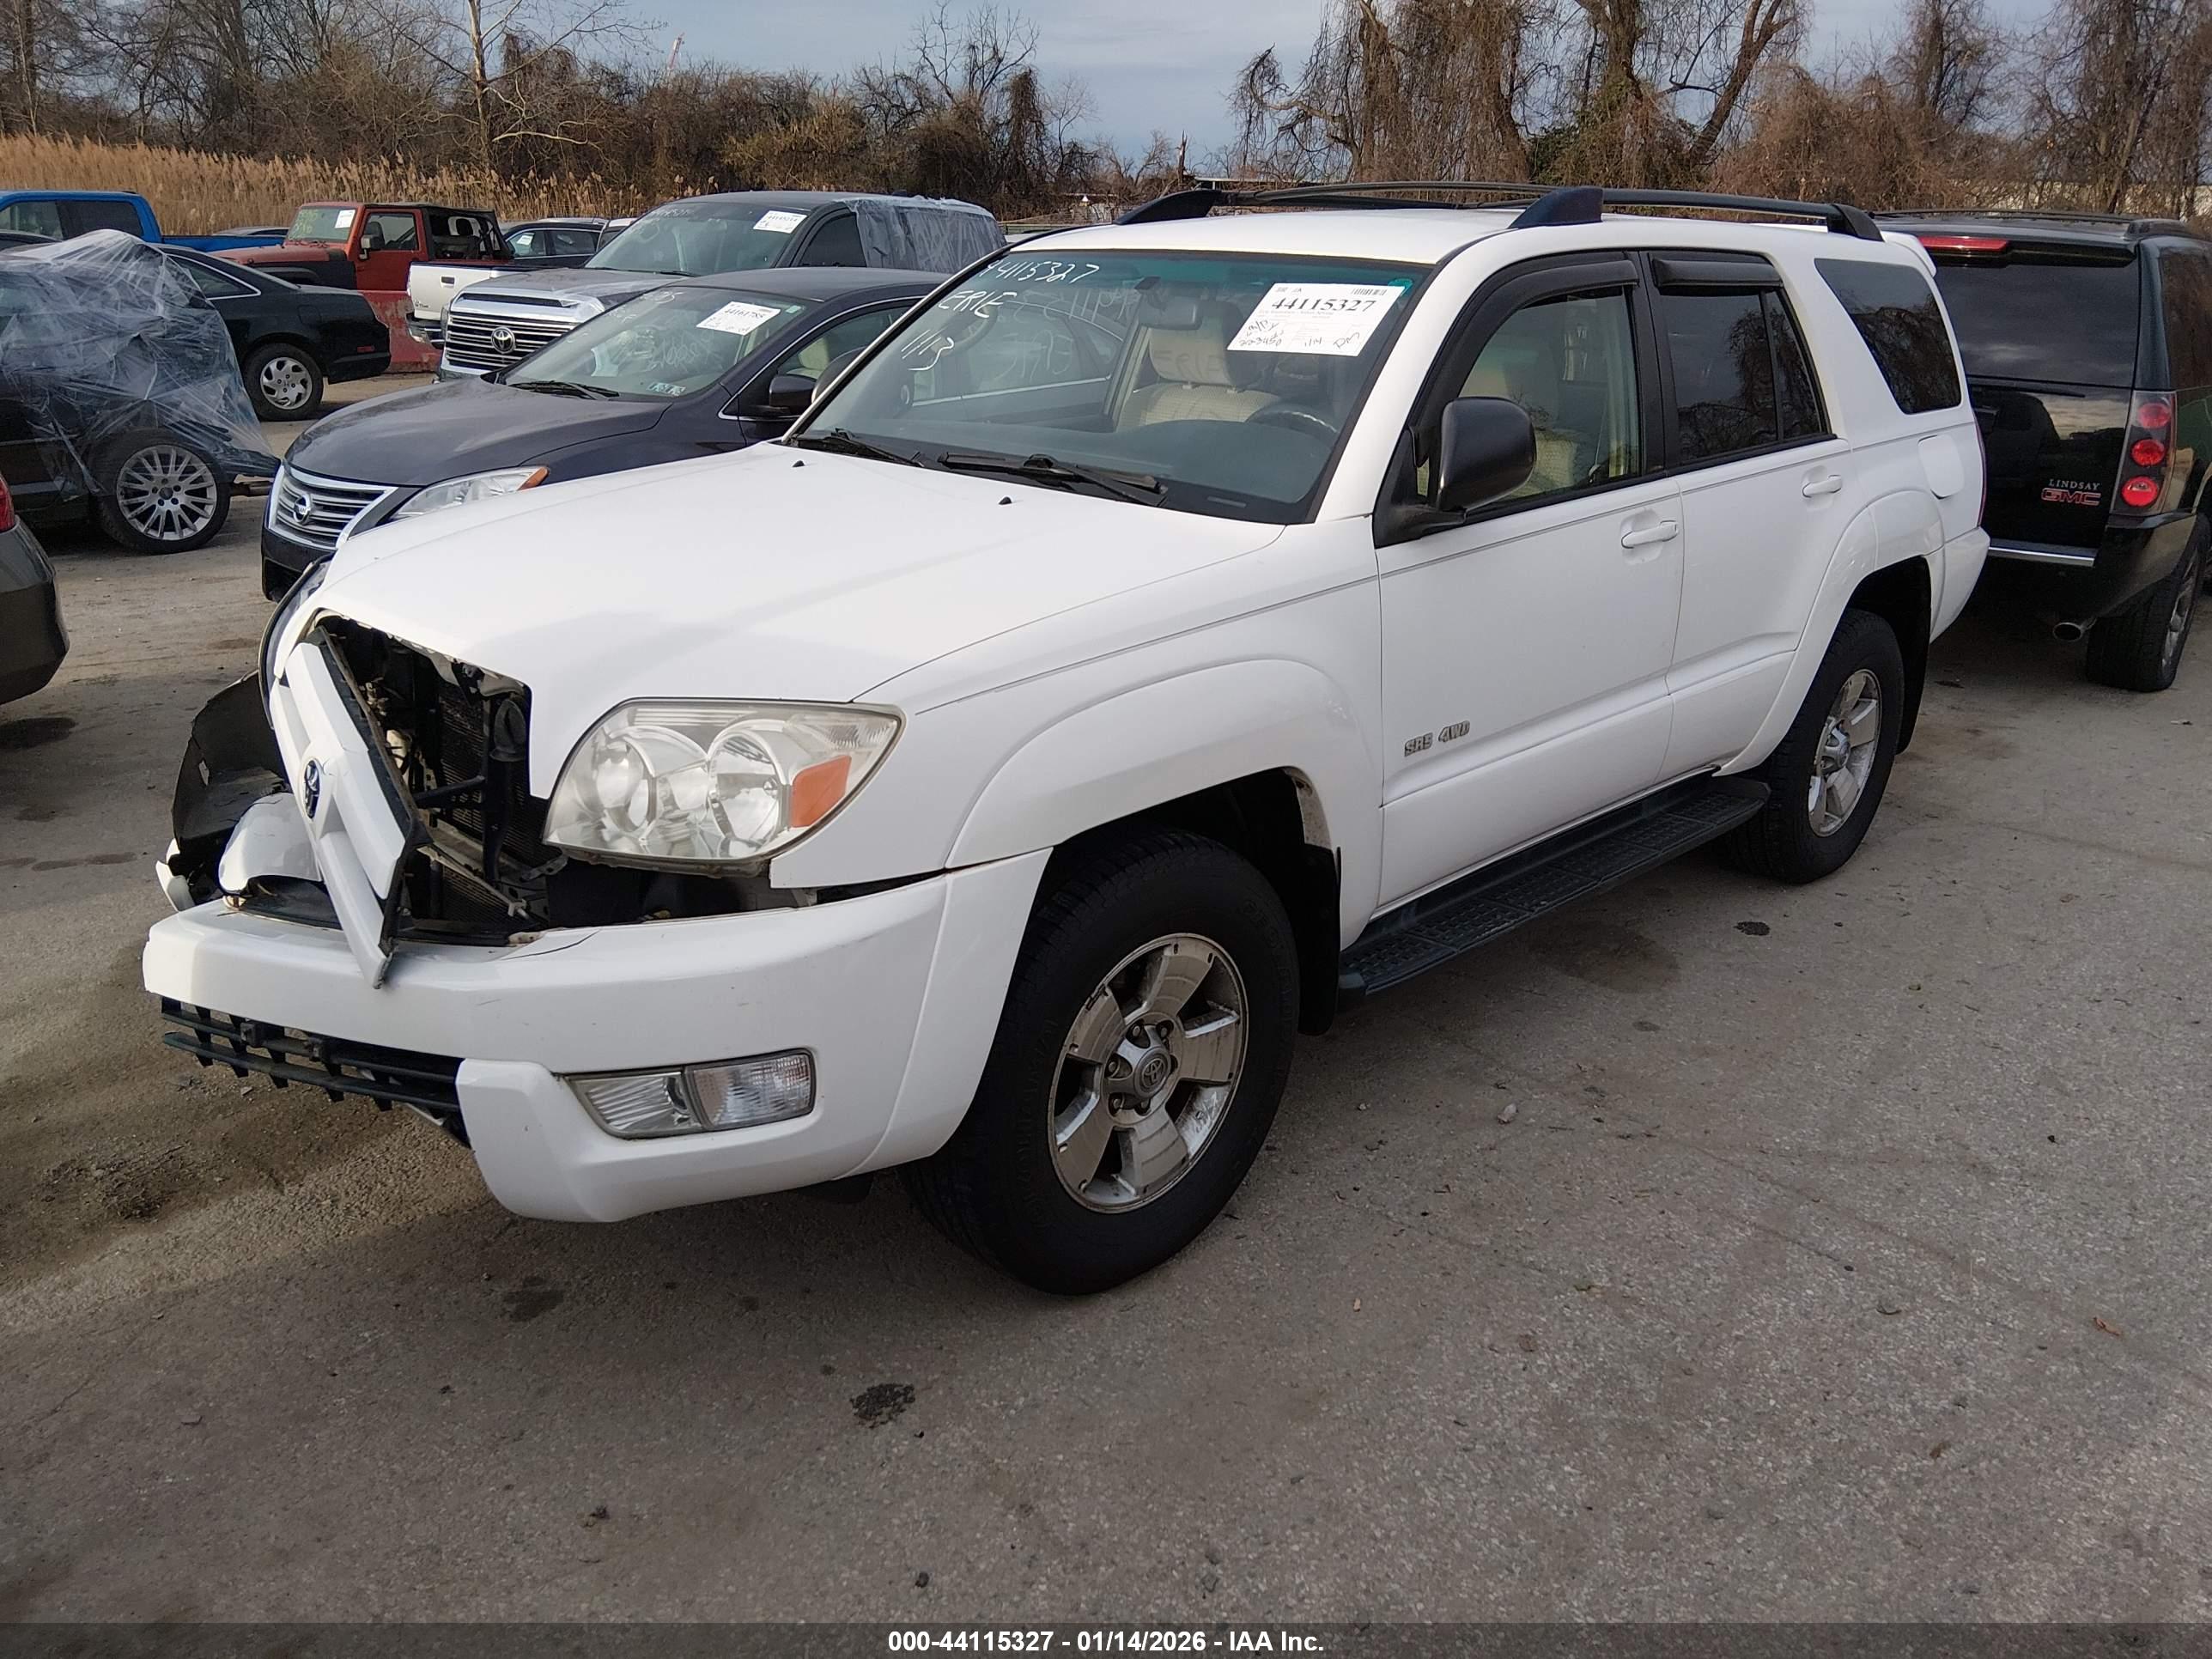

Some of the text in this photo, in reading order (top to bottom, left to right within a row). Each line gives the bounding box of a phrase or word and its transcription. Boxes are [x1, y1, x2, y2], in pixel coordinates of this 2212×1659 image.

[939, 289, 1018, 319] ERIE
[1272, 297, 1376, 312] 44115327
[2049, 479, 2100, 489] LINDSAY
[2041, 487, 2102, 507] GMC
[1438, 720, 1470, 742] 4WD
